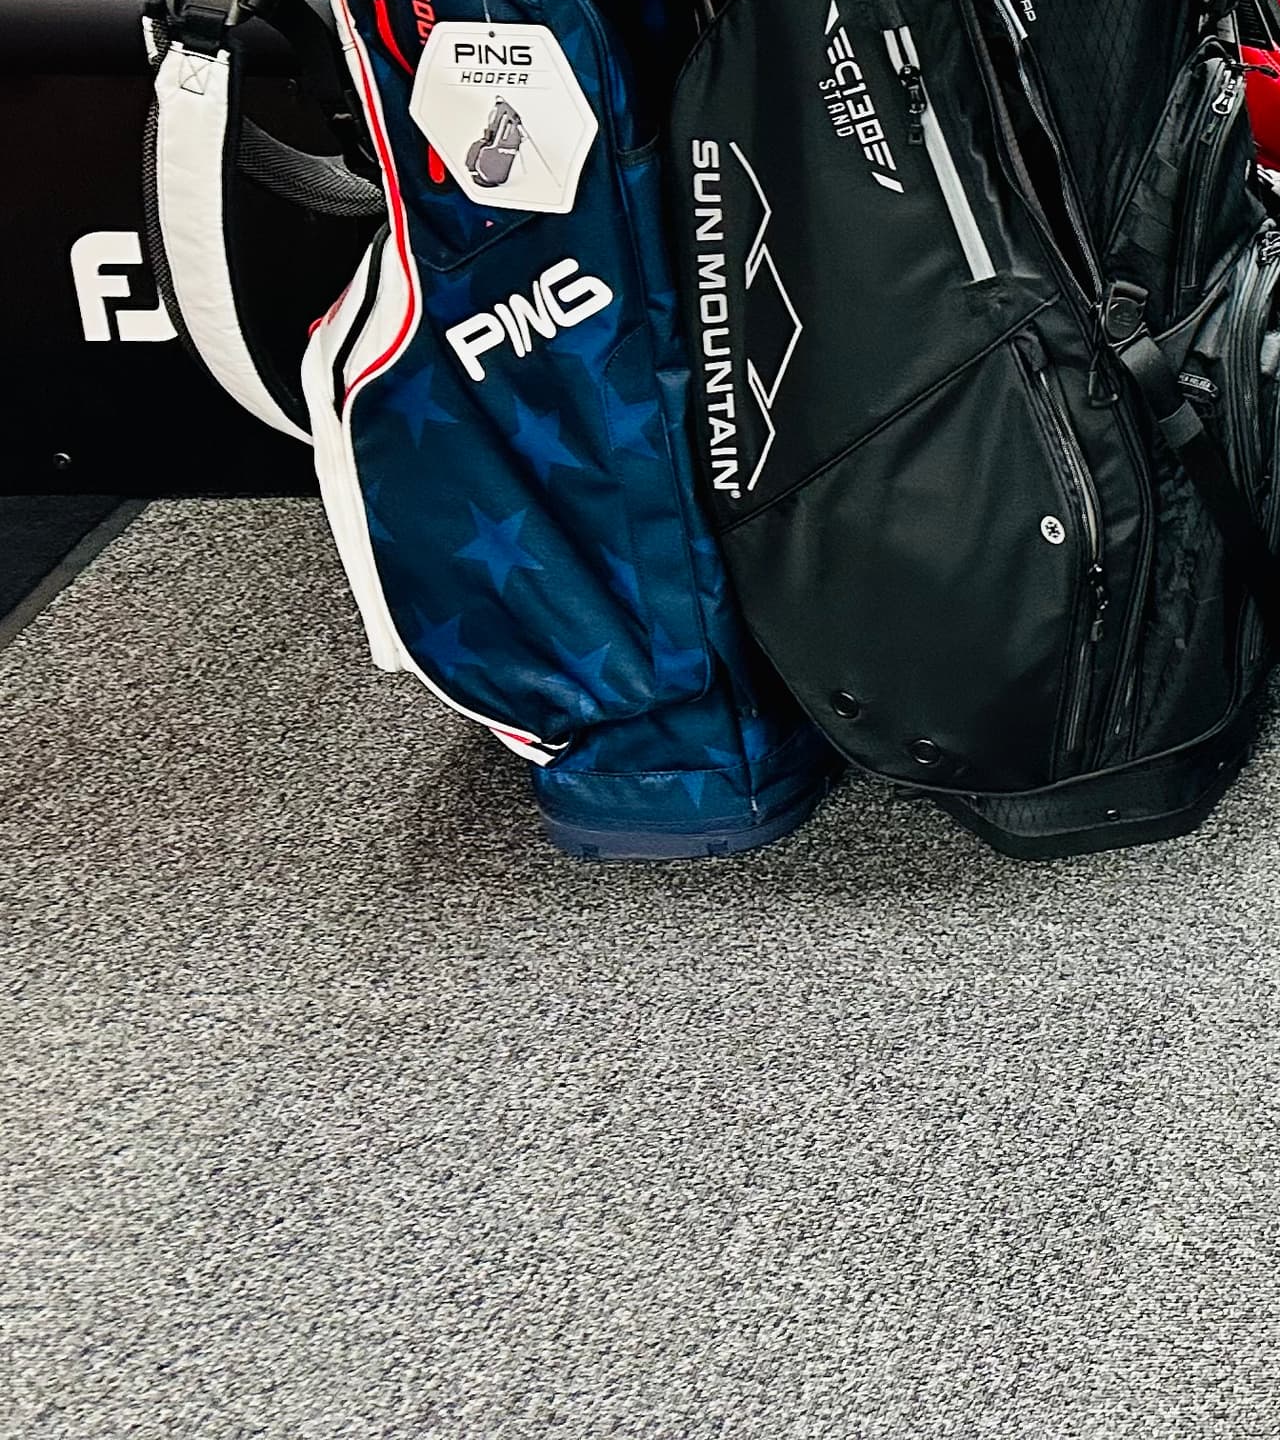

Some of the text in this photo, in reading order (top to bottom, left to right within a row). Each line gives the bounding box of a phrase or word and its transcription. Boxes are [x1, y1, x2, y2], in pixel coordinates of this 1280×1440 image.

[453, 42, 534, 67] PING
[460, 70, 530, 86] HOOFER
[817, 76, 855, 139] STAND
[69, 230, 179, 343] FJ
[445, 257, 613, 382] PING
[691, 138, 739, 492] SUN MOUNTAIN
